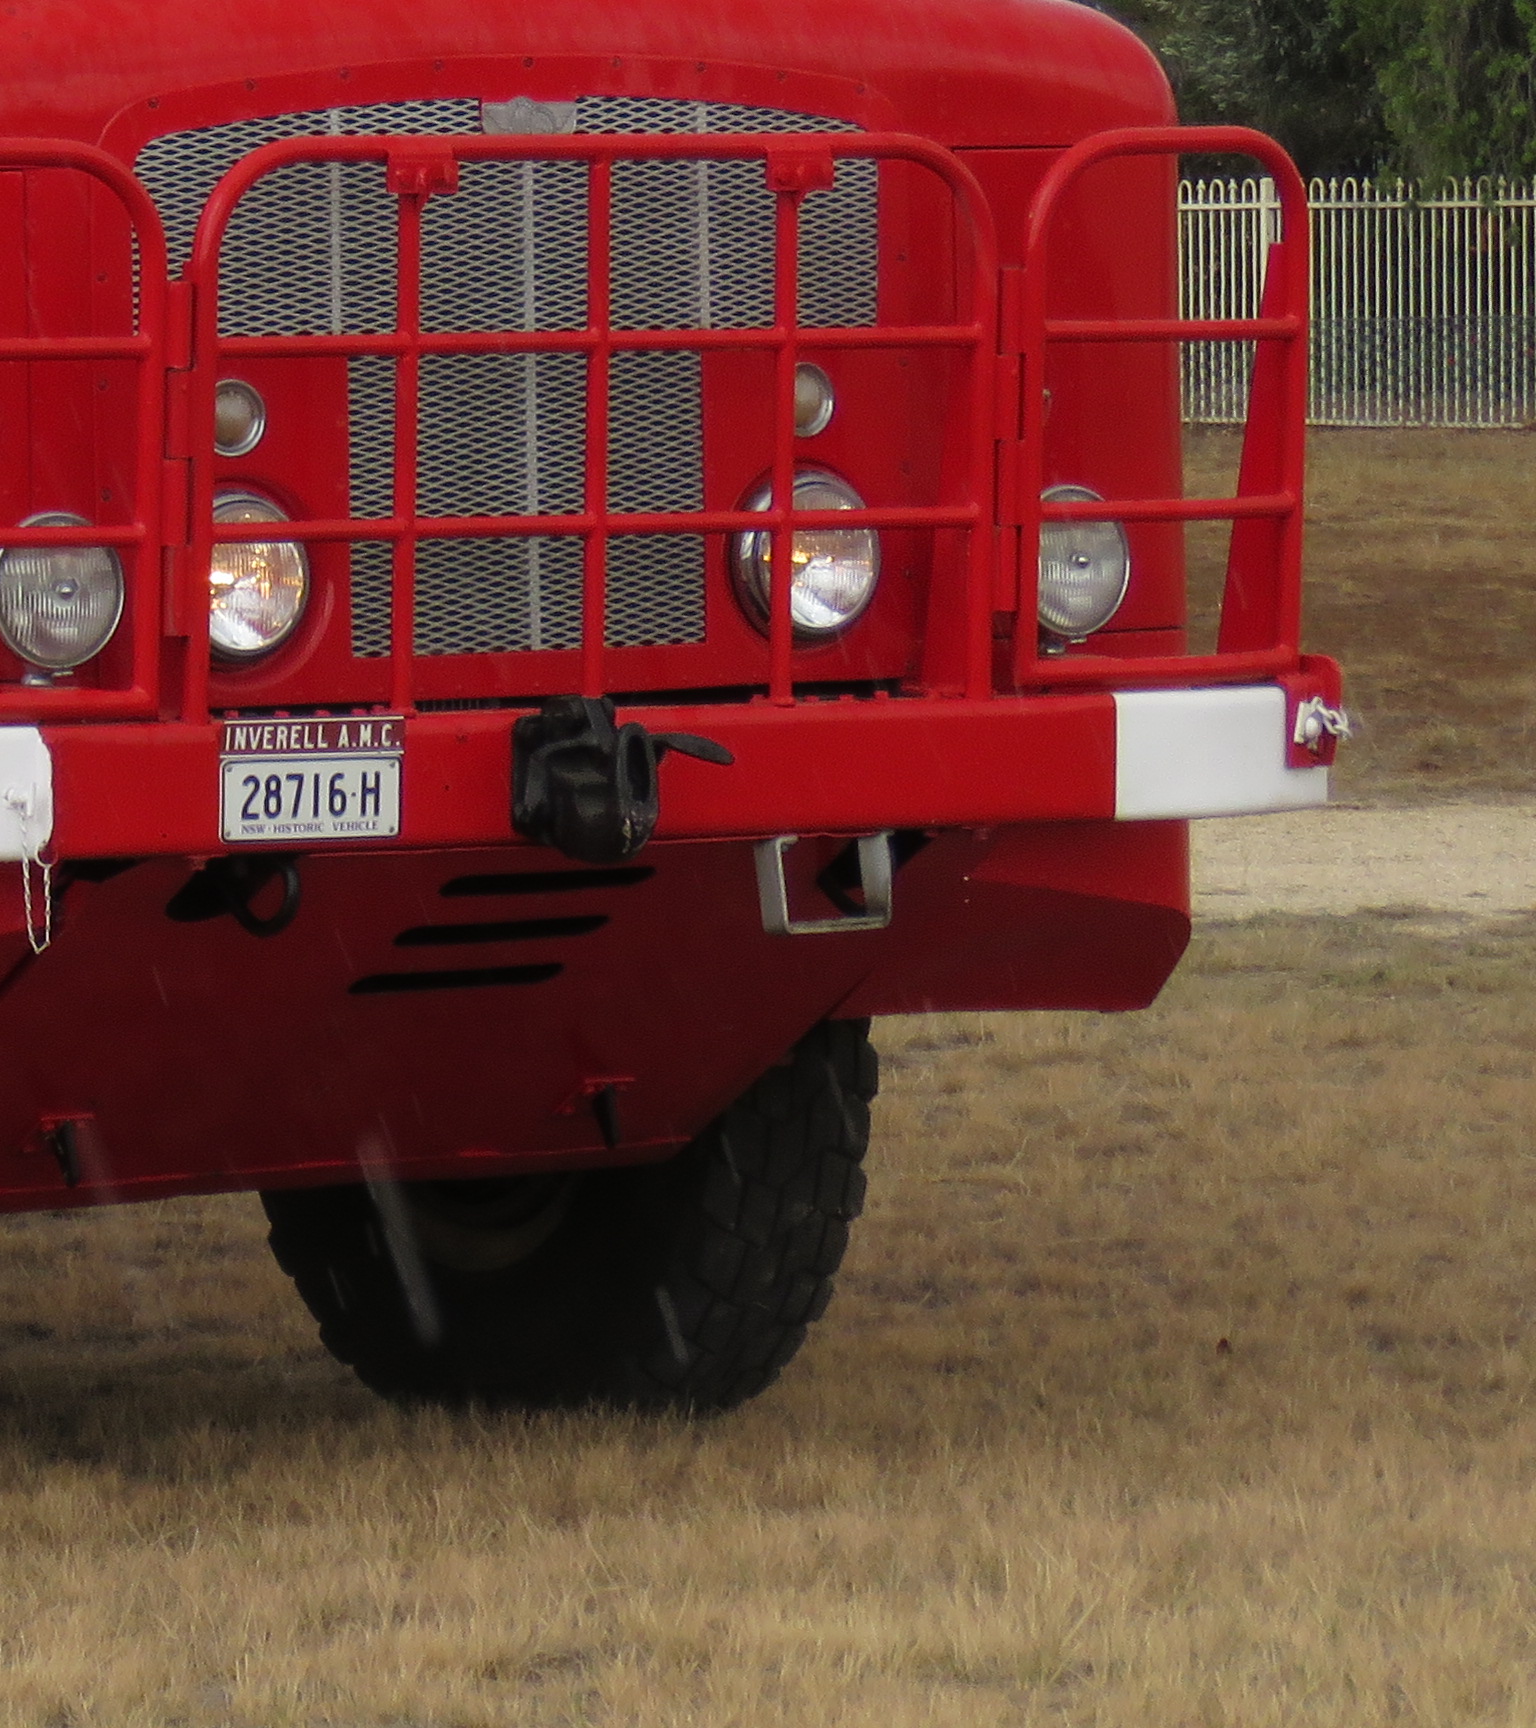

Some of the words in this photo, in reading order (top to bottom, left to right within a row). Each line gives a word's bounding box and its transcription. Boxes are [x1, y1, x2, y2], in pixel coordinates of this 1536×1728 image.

[225, 724, 328, 751] INVERELL
[337, 723, 401, 749] A.M.C.
[241, 823, 267, 835] NSW
[272, 822, 325, 834] HISTORIC
[332, 820, 379, 832] VEHICLE
